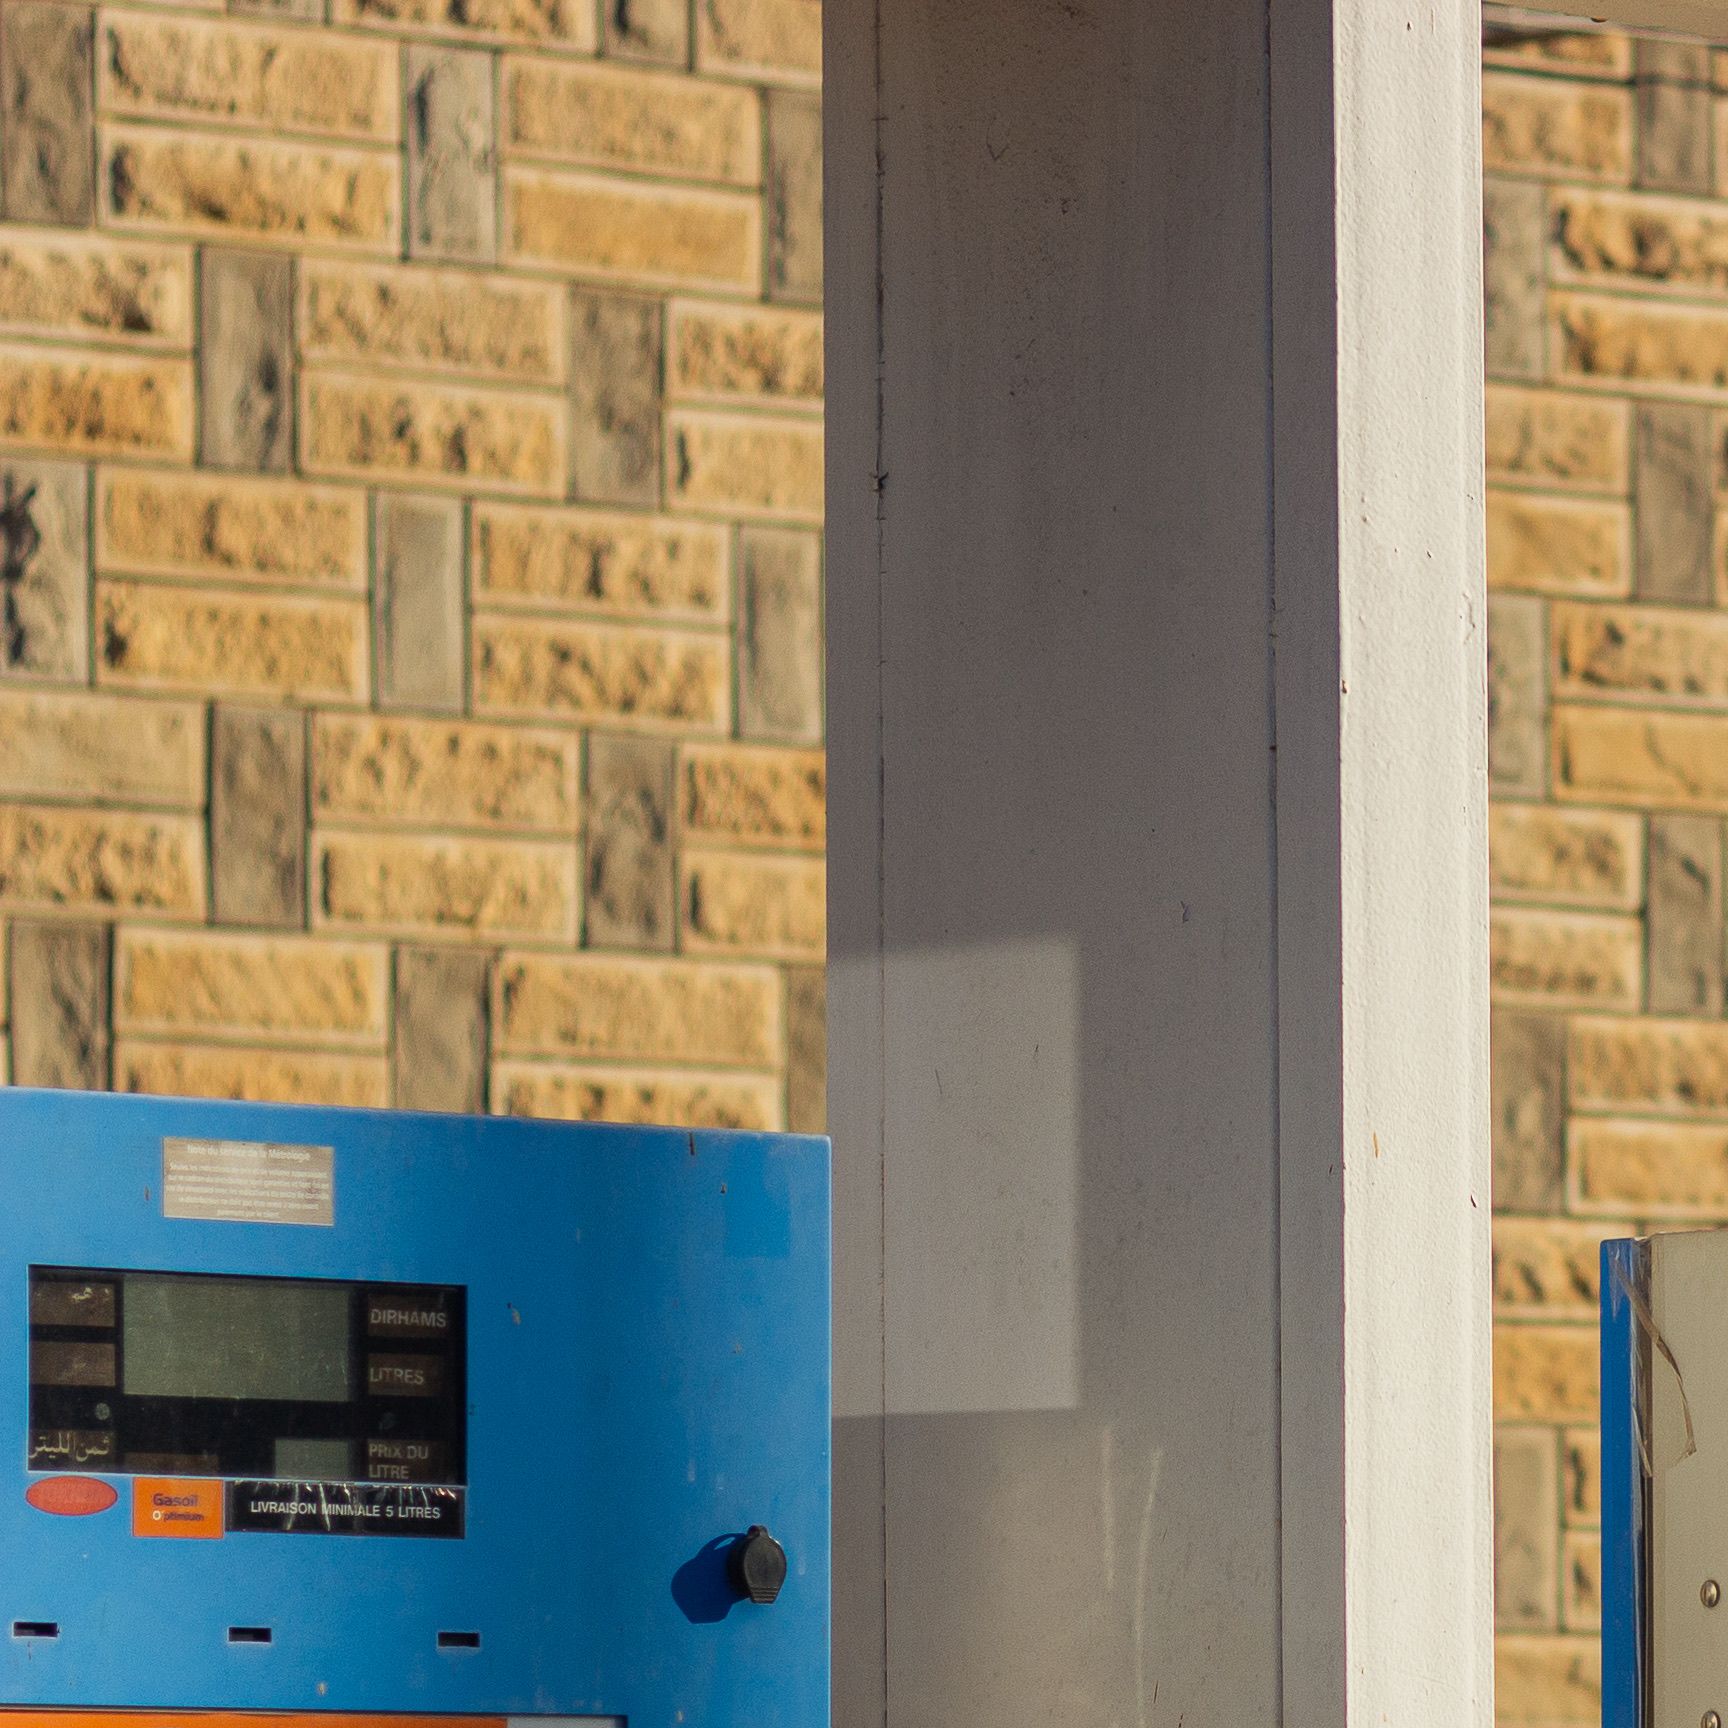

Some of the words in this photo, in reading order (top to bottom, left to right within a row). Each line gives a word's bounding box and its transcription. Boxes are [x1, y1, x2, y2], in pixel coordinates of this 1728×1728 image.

[370, 1308, 447, 1328] DIRHAMS
[370, 1367, 425, 1386] LITRES
[407, 1445, 429, 1460] DU
[369, 1464, 409, 1480] LITRE
[250, 1500, 317, 1514] LIVRAISON
[321, 1502, 381, 1517] MINIMALE
[385, 1505, 394, 1517] 5
[398, 1506, 441, 1519] LITRES
